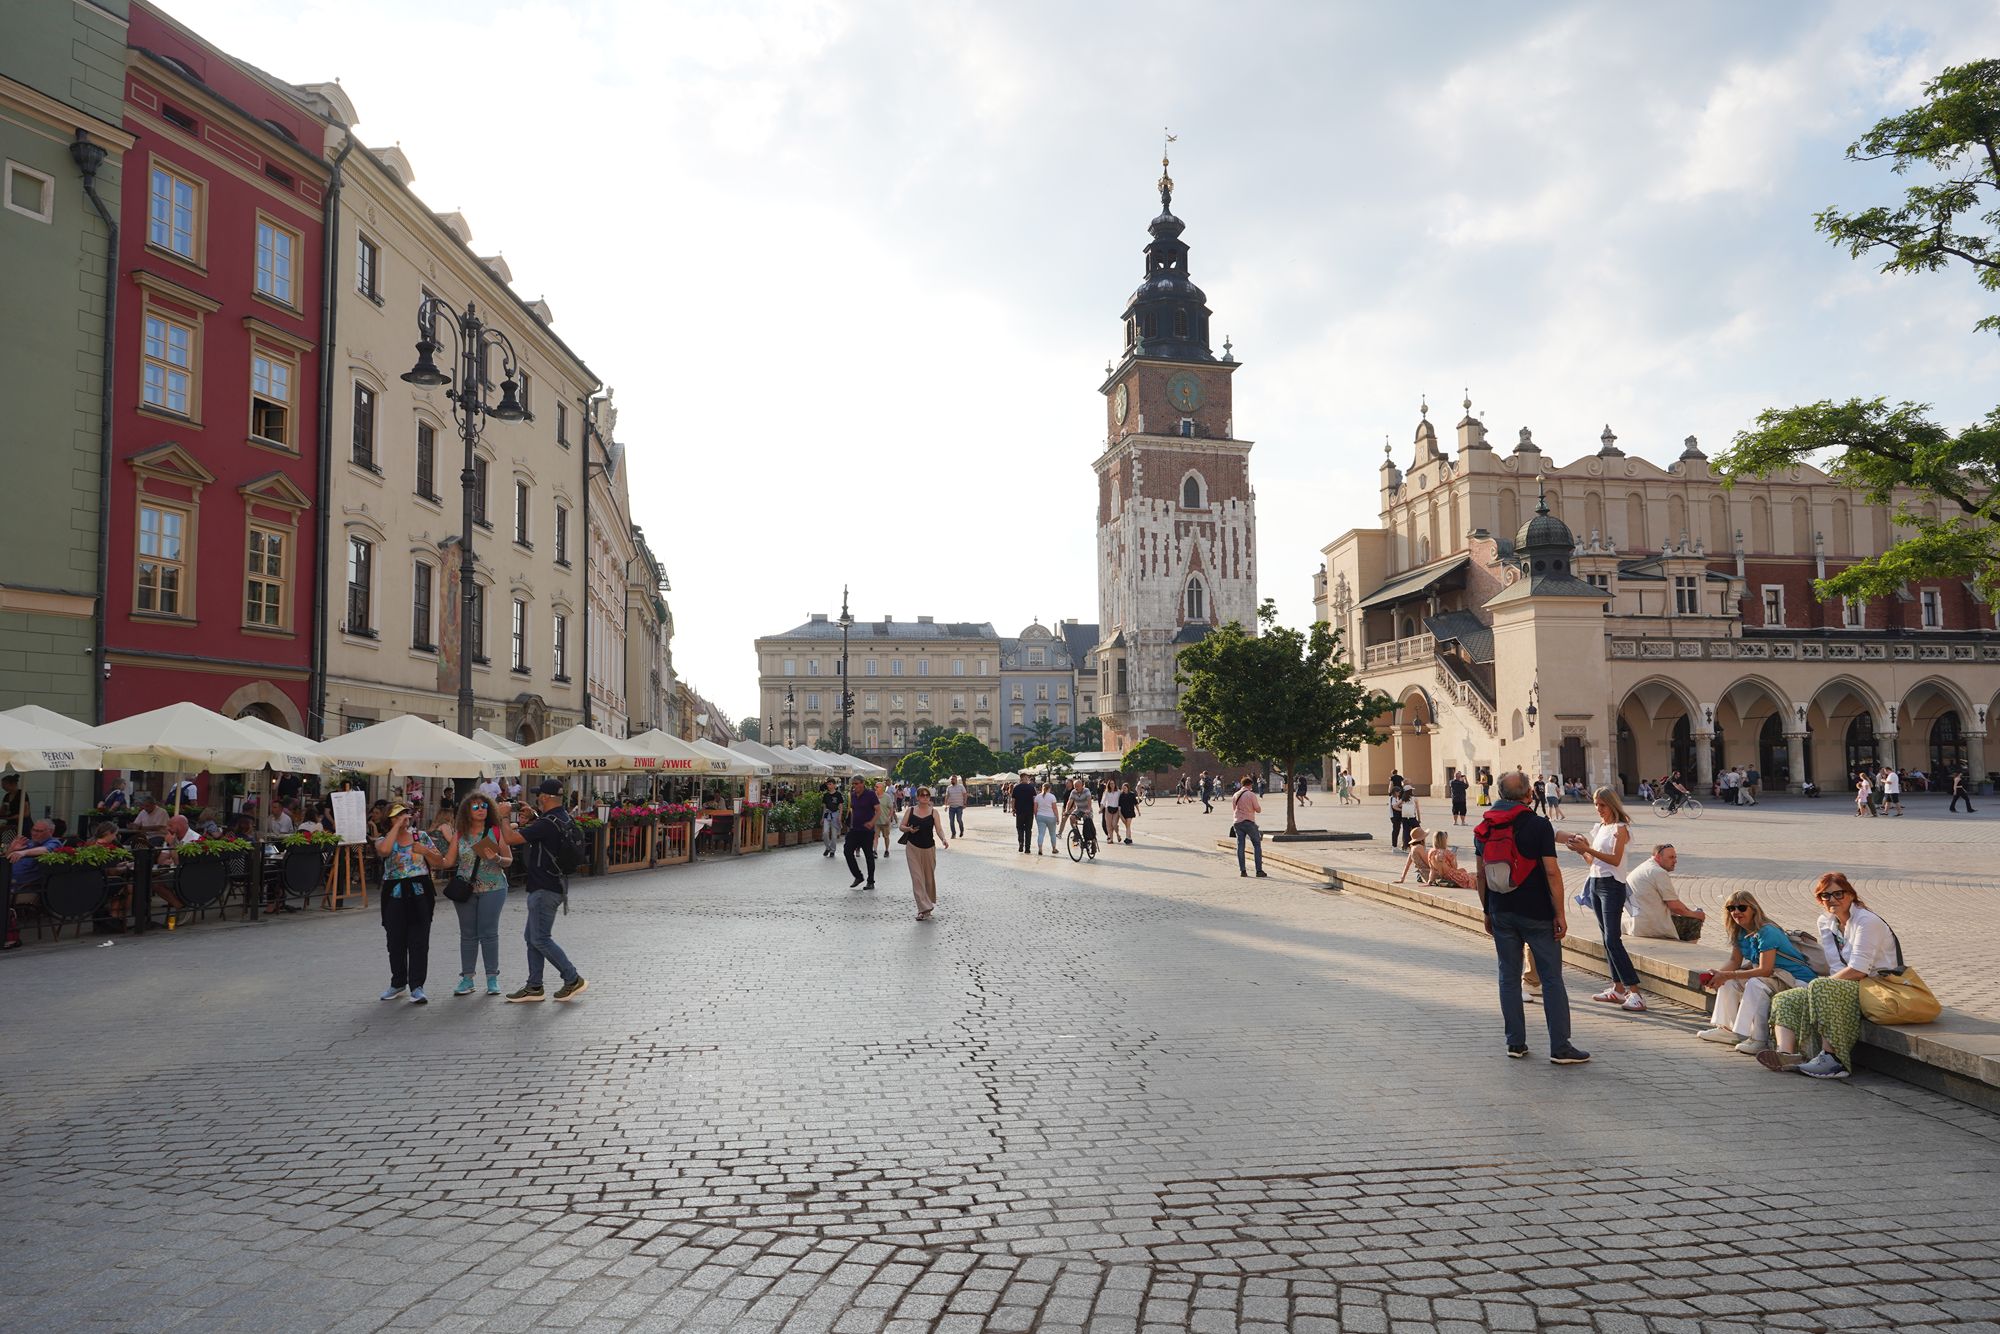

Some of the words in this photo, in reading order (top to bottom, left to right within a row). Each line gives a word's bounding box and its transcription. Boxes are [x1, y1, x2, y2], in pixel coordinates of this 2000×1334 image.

[41, 751, 75, 761] PERONI
[337, 759, 365, 768] PERONI
[520, 759, 539, 768] WIEC
[567, 759, 592, 768] MAX
[594, 758, 607, 768] 18
